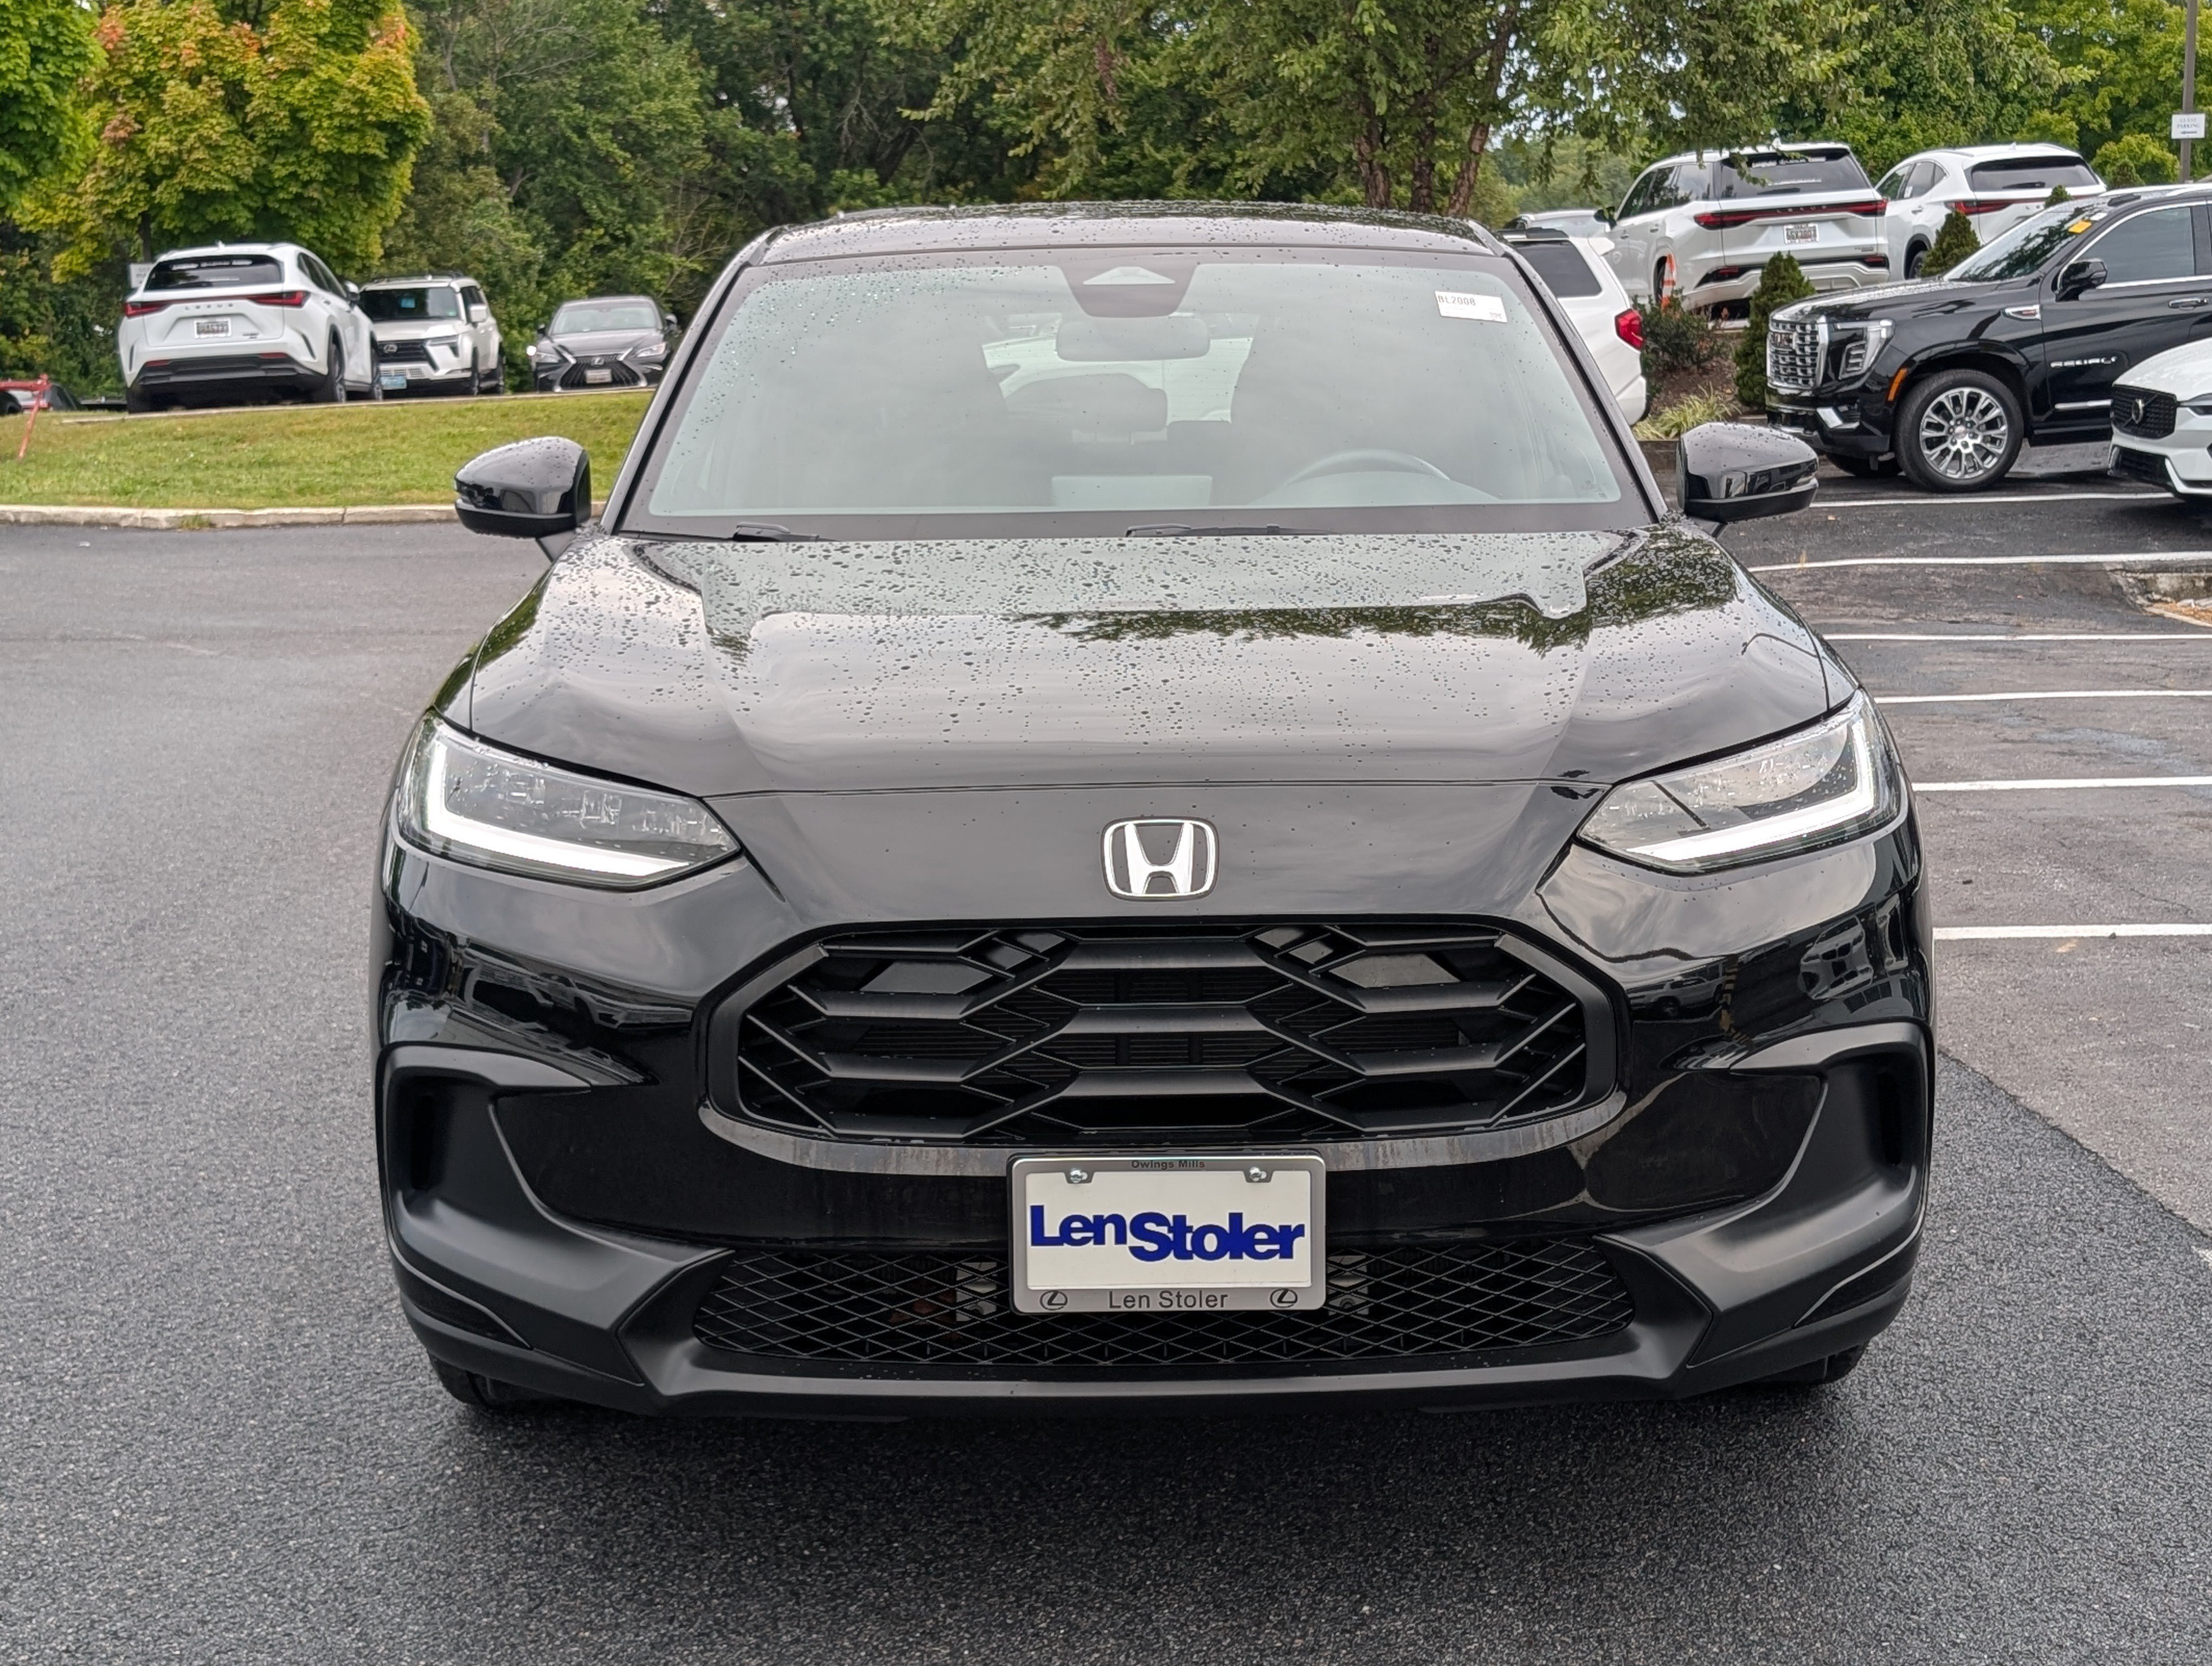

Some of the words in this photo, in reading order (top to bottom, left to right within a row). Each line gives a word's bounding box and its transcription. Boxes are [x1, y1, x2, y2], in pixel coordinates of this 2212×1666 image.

[1131, 1159, 1174, 1171] Owings
[1178, 1159, 1206, 1168] Mills
[1109, 1291, 1150, 1309] Len
[1159, 1290, 1229, 1308] Stoler
